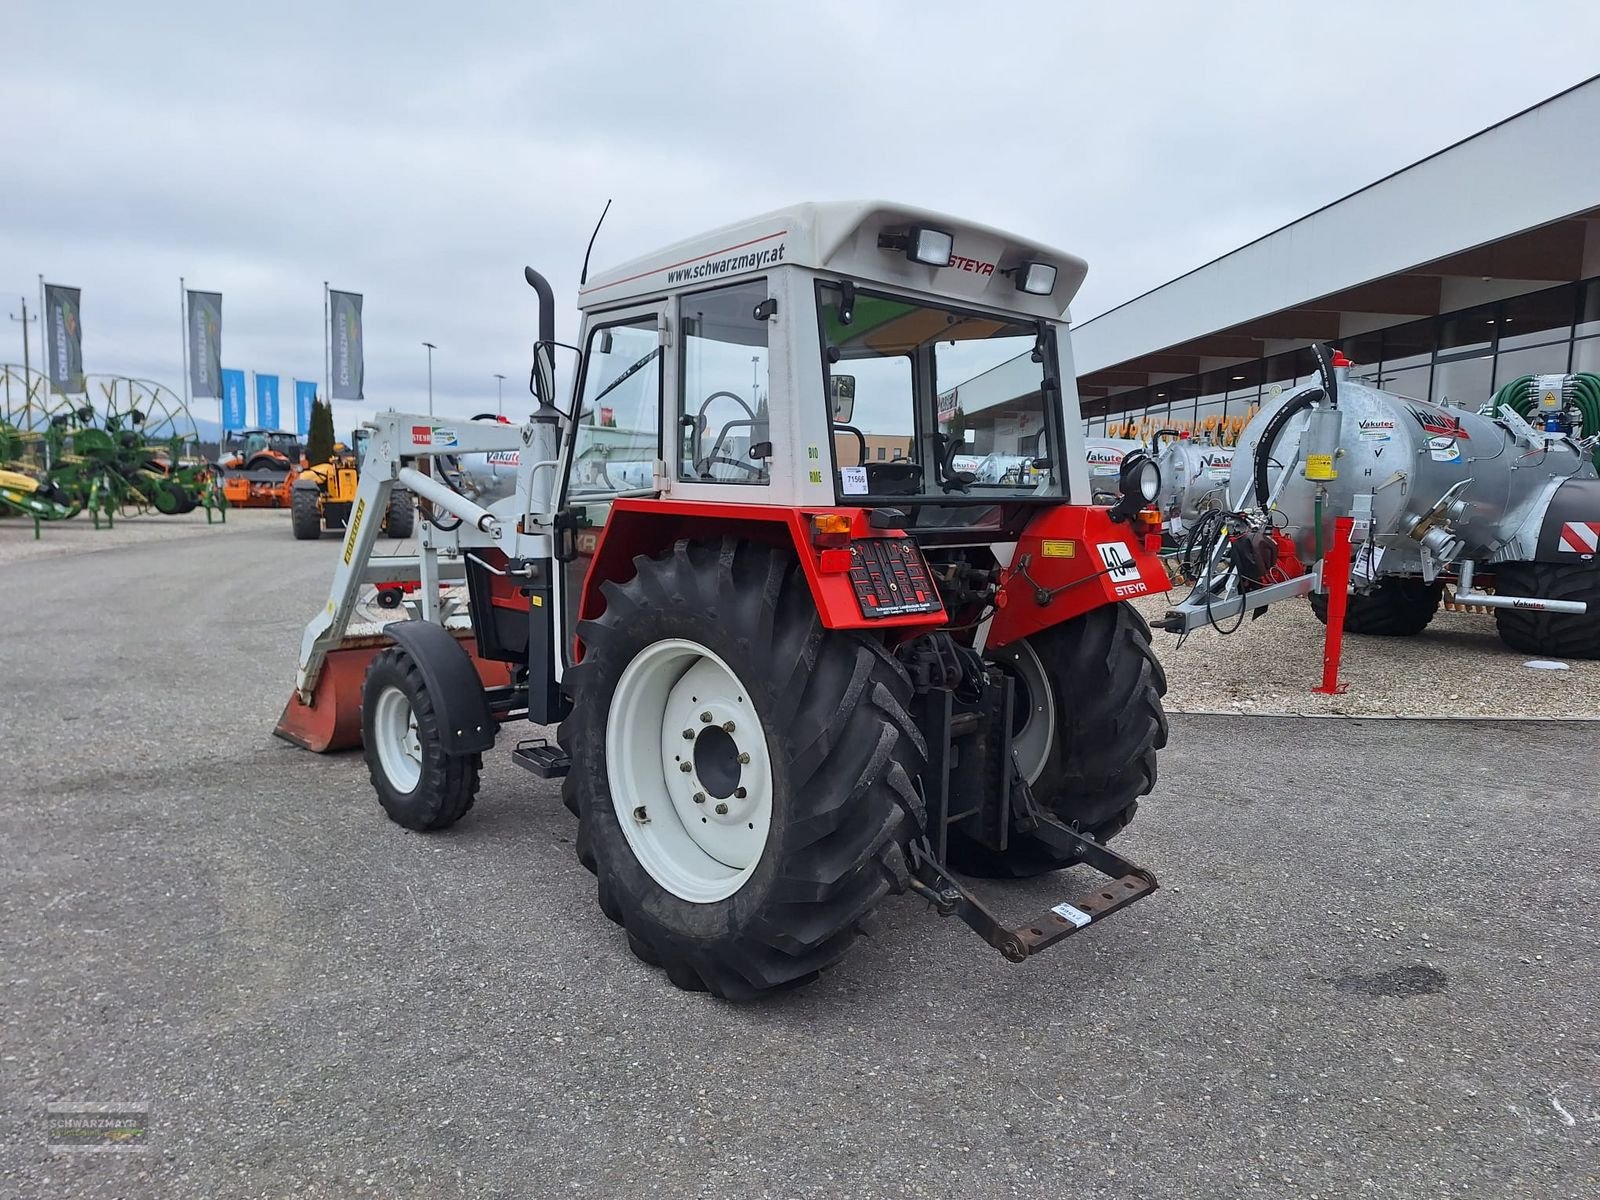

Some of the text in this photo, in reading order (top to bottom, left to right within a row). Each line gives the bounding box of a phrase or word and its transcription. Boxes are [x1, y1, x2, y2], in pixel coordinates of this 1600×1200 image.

[668, 243, 785, 283] www.schwarzmayr.at
[948, 255, 995, 276] STEYR
[55, 305, 69, 381] SCHWARZMAYR
[1359, 420, 1394, 429] Vakutec
[1403, 403, 1465, 431] Vakute
[1102, 547, 1126, 577] 40
[1115, 583, 1147, 596] STEYR
[1513, 600, 1544, 609] Vakutec
